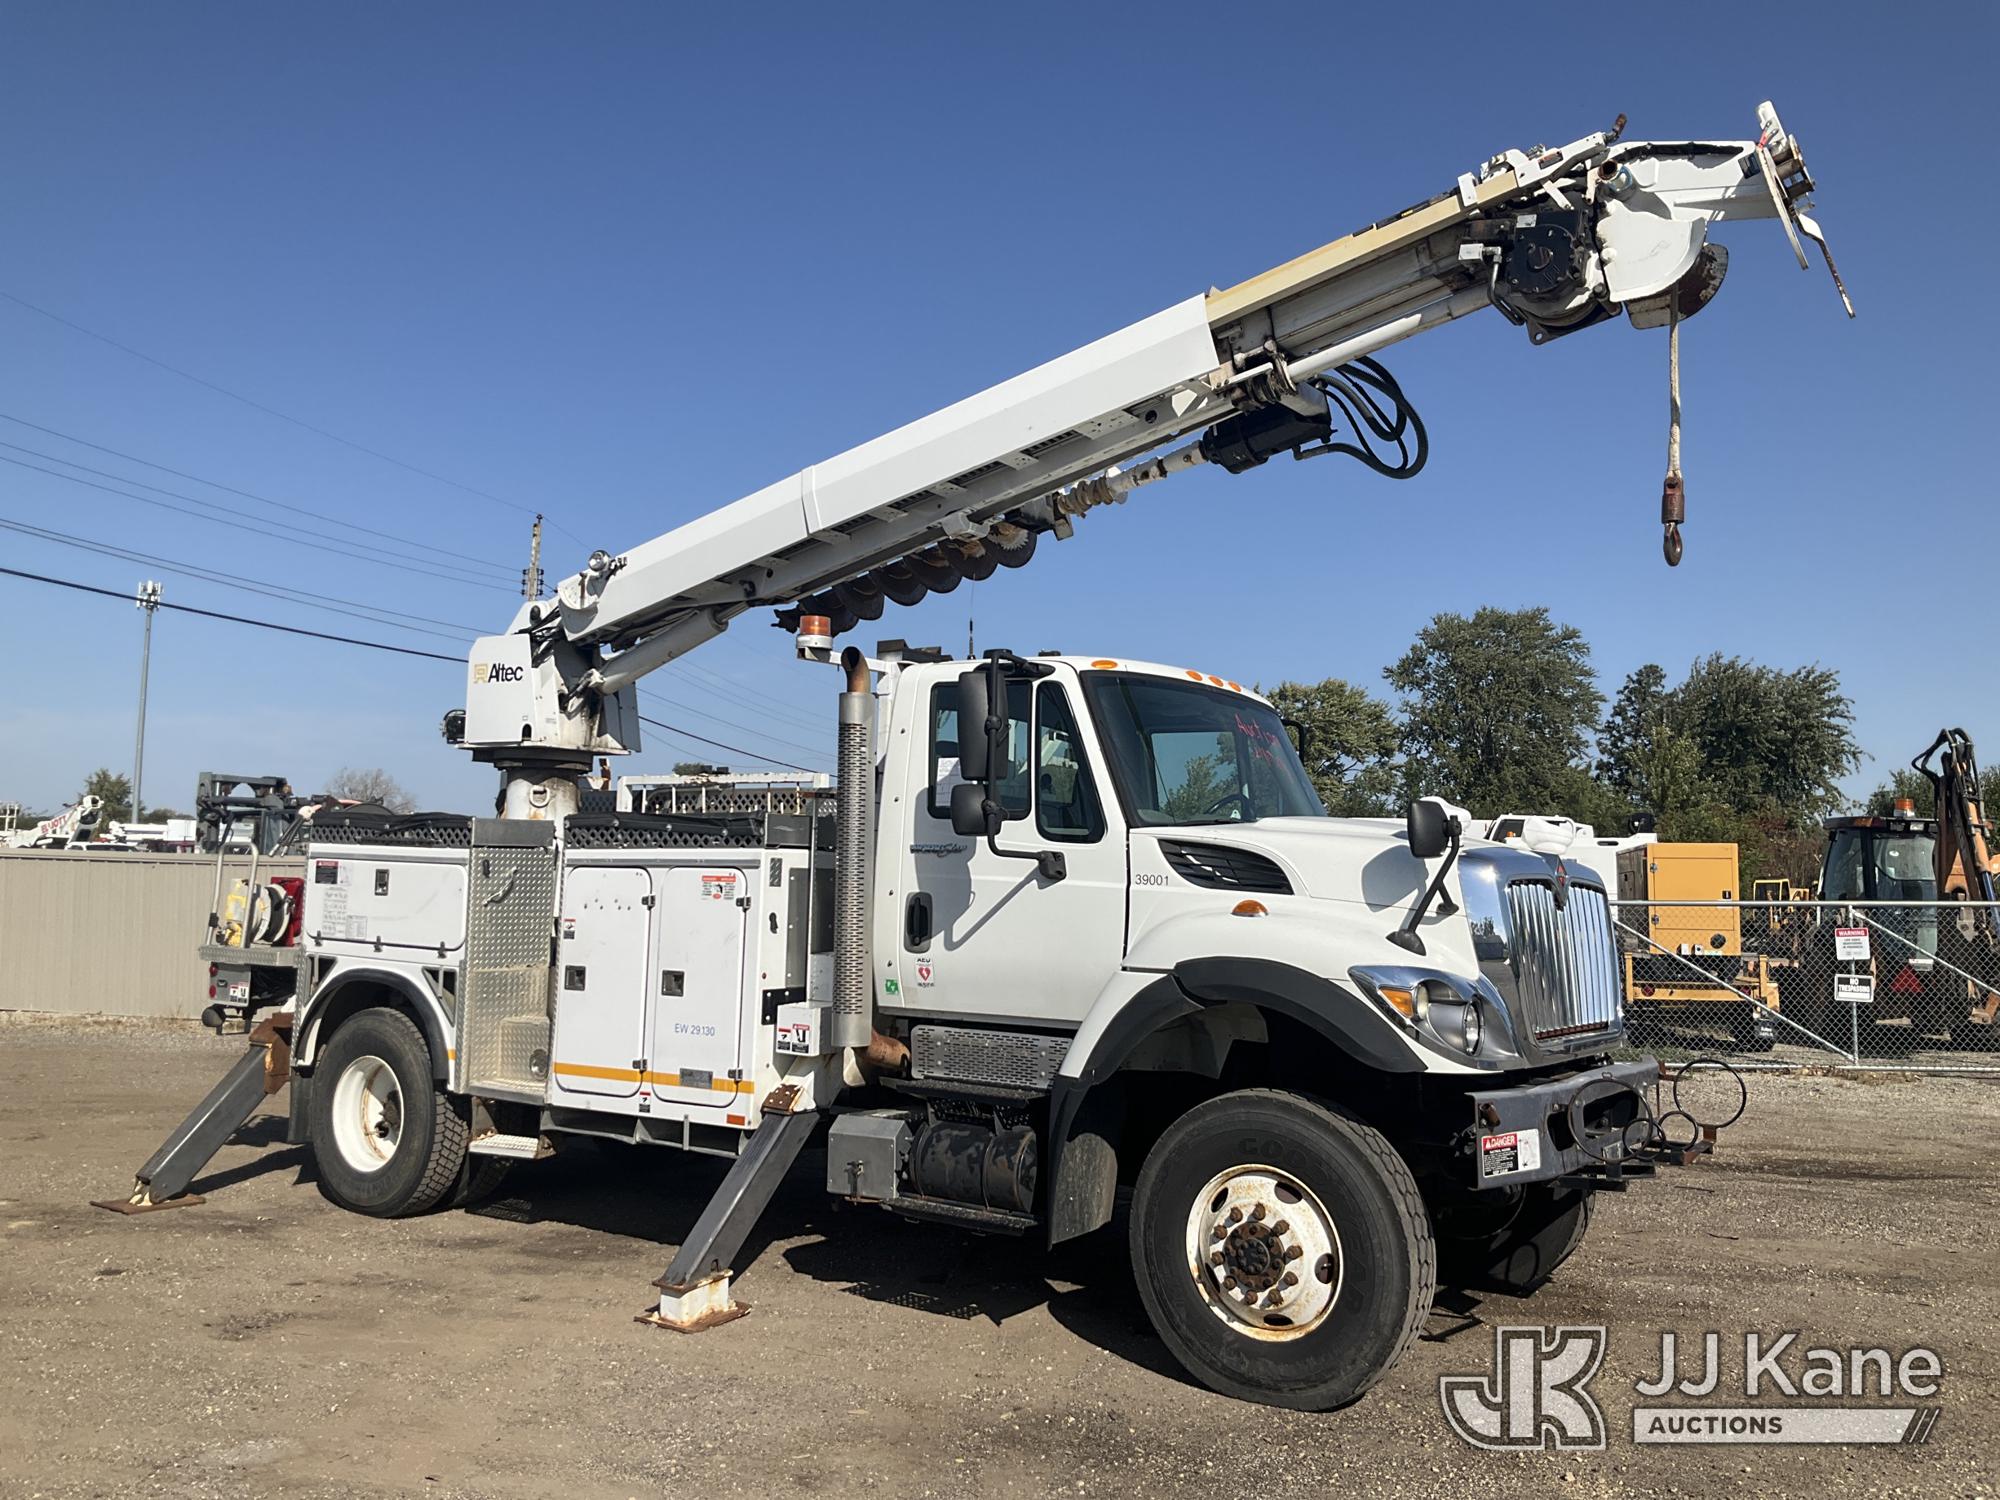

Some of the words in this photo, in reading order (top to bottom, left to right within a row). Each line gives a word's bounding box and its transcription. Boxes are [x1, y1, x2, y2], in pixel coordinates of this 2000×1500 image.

[488, 663, 523, 682] Altec
[1135, 873, 1169, 886] 39001
[1838, 984, 1870, 992] TRESPASSING
[674, 1023, 689, 1034] EW
[690, 1024, 716, 1037] 29130
[1490, 1135, 1515, 1148] DANGER
